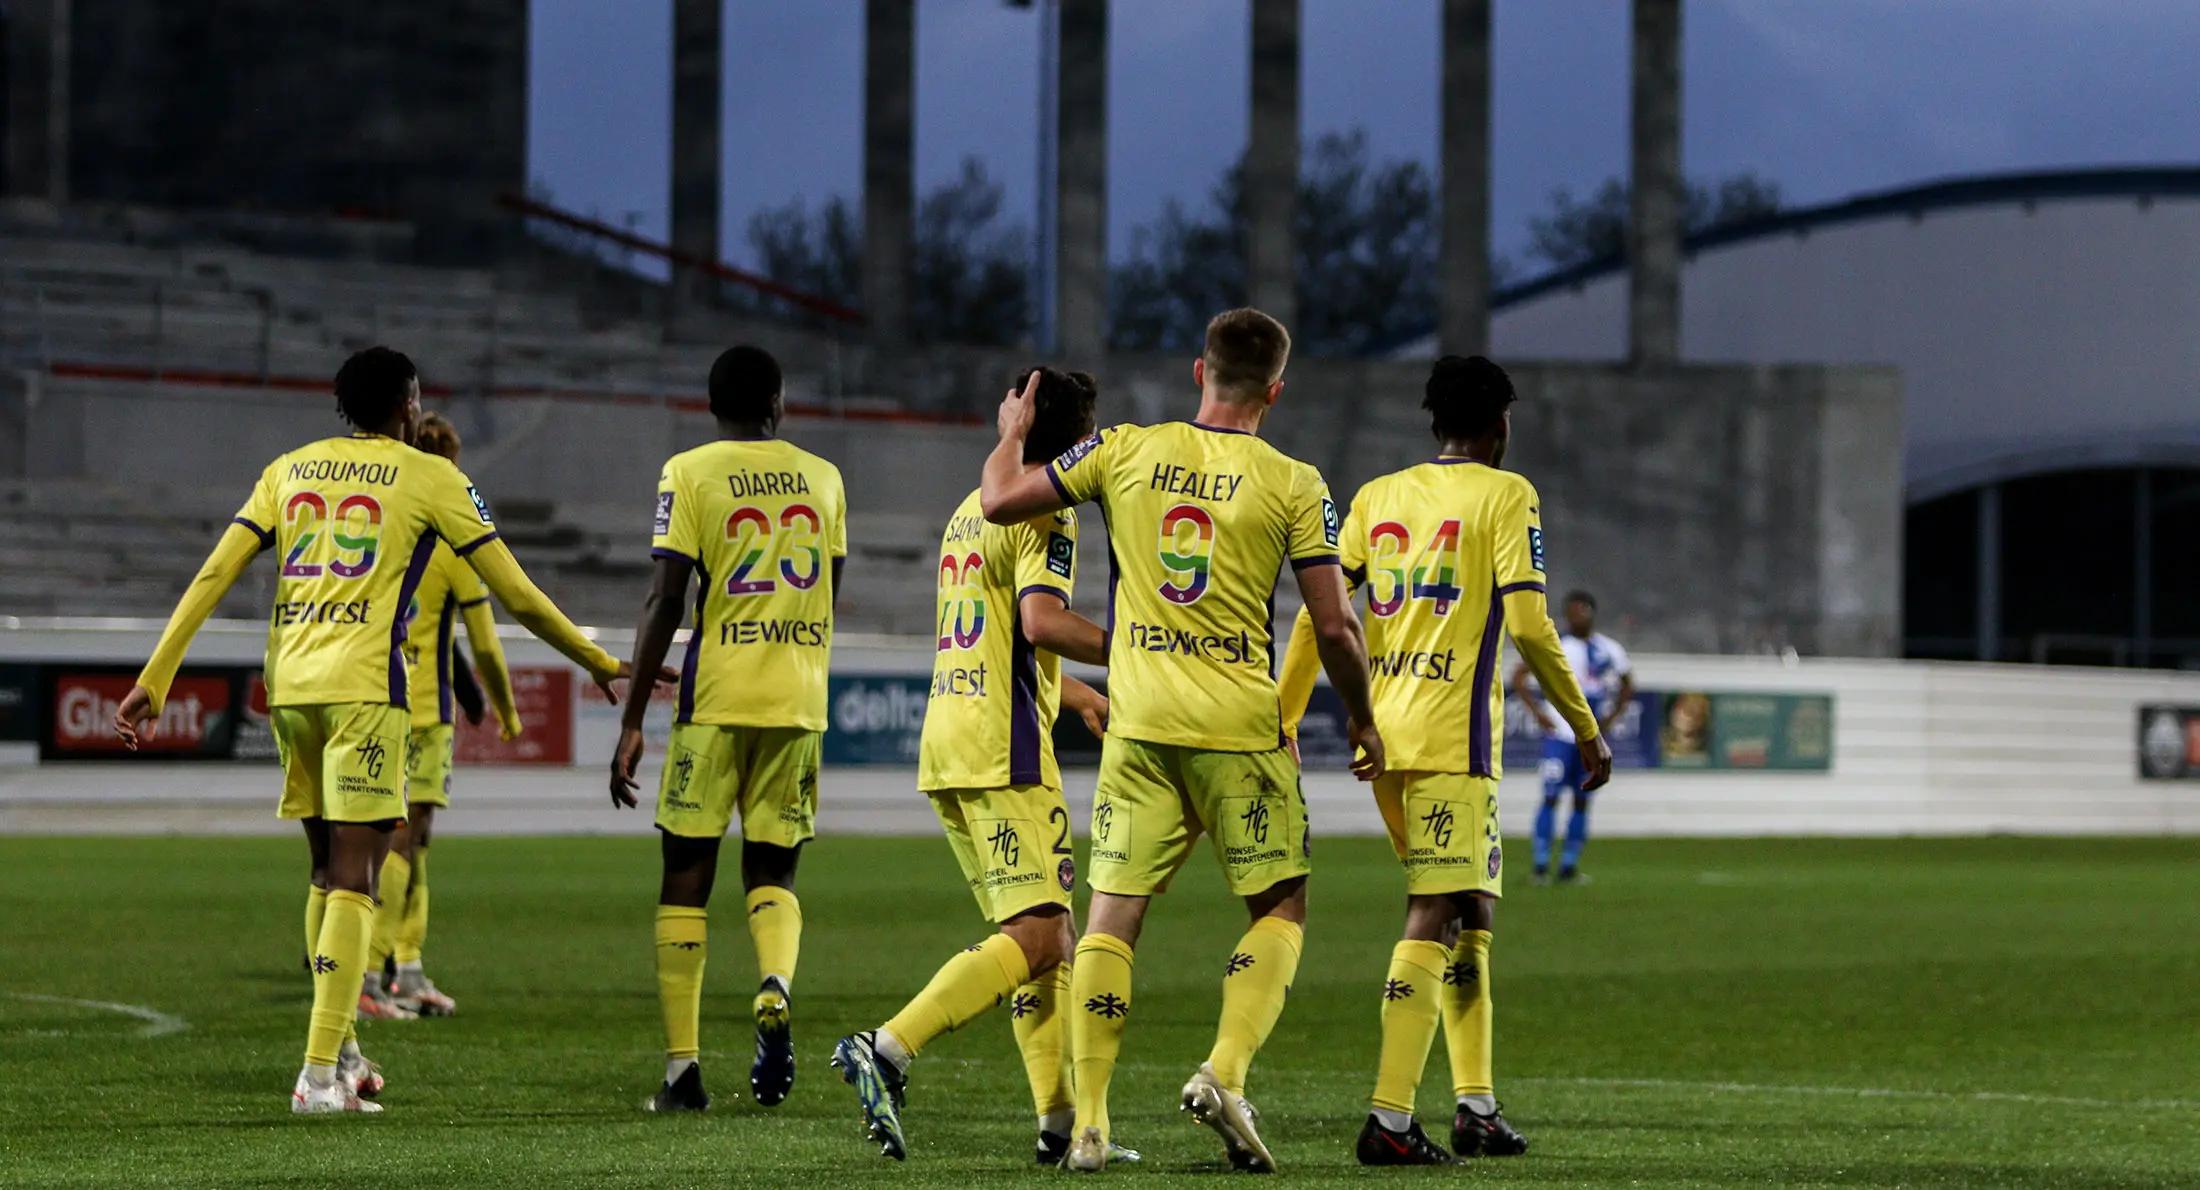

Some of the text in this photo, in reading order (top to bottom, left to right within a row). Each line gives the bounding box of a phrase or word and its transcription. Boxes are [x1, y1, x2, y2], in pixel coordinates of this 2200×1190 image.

[288, 460, 398, 486] NGOUMOU
[1151, 463, 1243, 502] HEALEY
[282, 491, 382, 580] 29
[725, 504, 821, 597] 23
[1157, 503, 1215, 606] 9
[1368, 520, 1464, 618] 34
[721, 616, 829, 649] newrest
[1129, 622, 1256, 664] newrest
